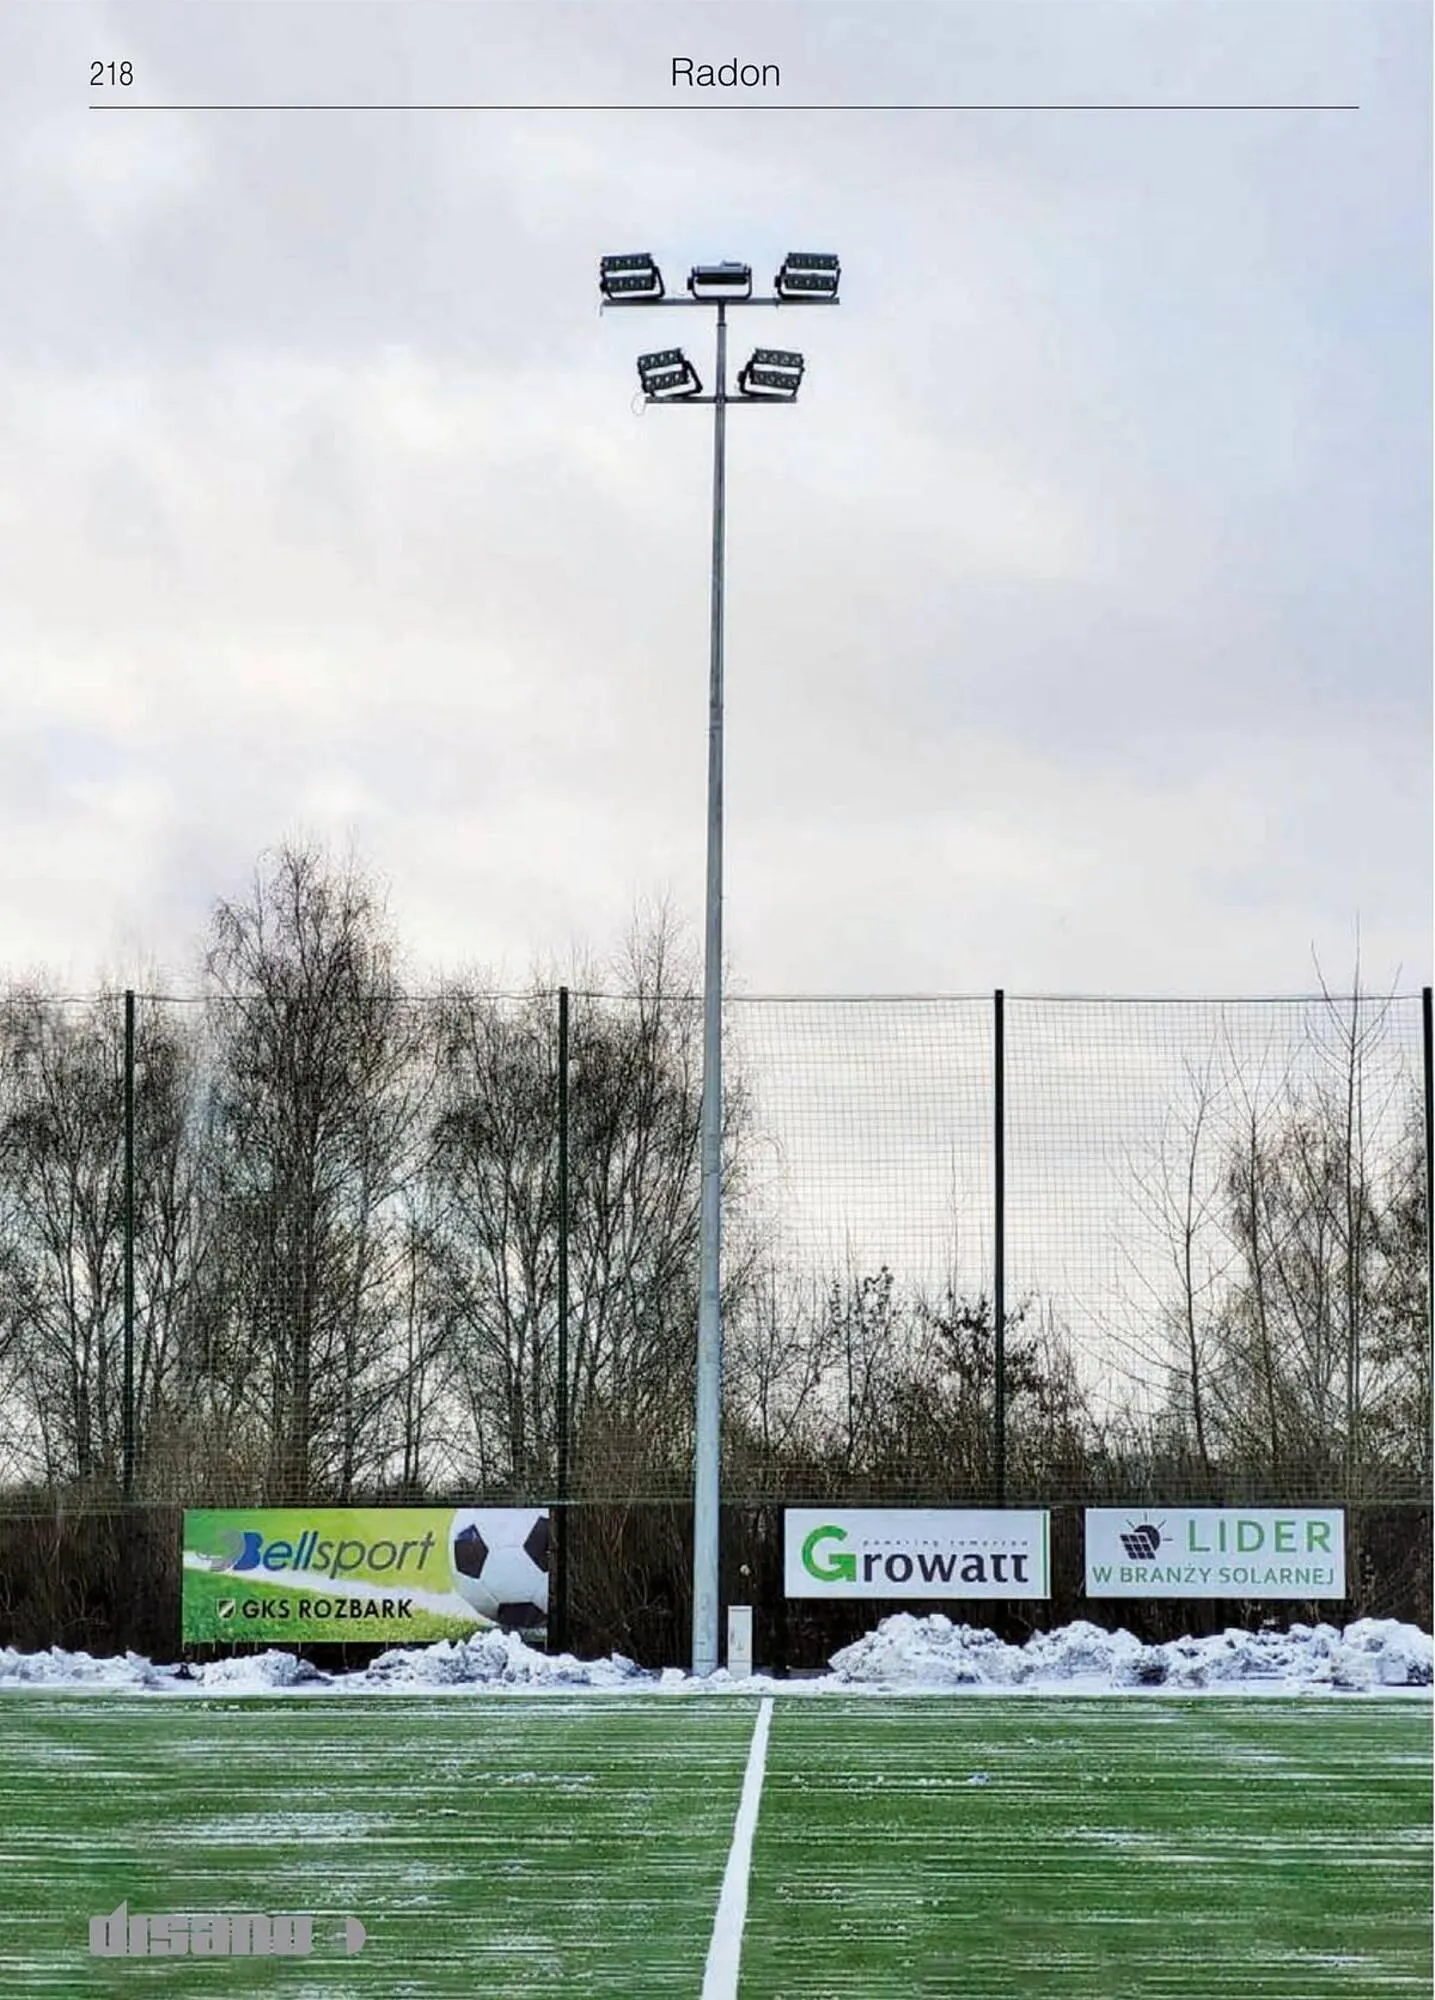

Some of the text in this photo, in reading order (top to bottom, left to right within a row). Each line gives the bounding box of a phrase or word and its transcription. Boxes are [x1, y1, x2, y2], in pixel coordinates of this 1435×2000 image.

[1187, 1519, 1332, 1553] LIDER
[233, 1530, 436, 1580] Bellsport
[801, 1525, 1029, 1583] Growatt
[1092, 1563, 1335, 1586] W BRANŻY SOLARNEJ
[241, 1598, 413, 1619] GKS ROZBARK
